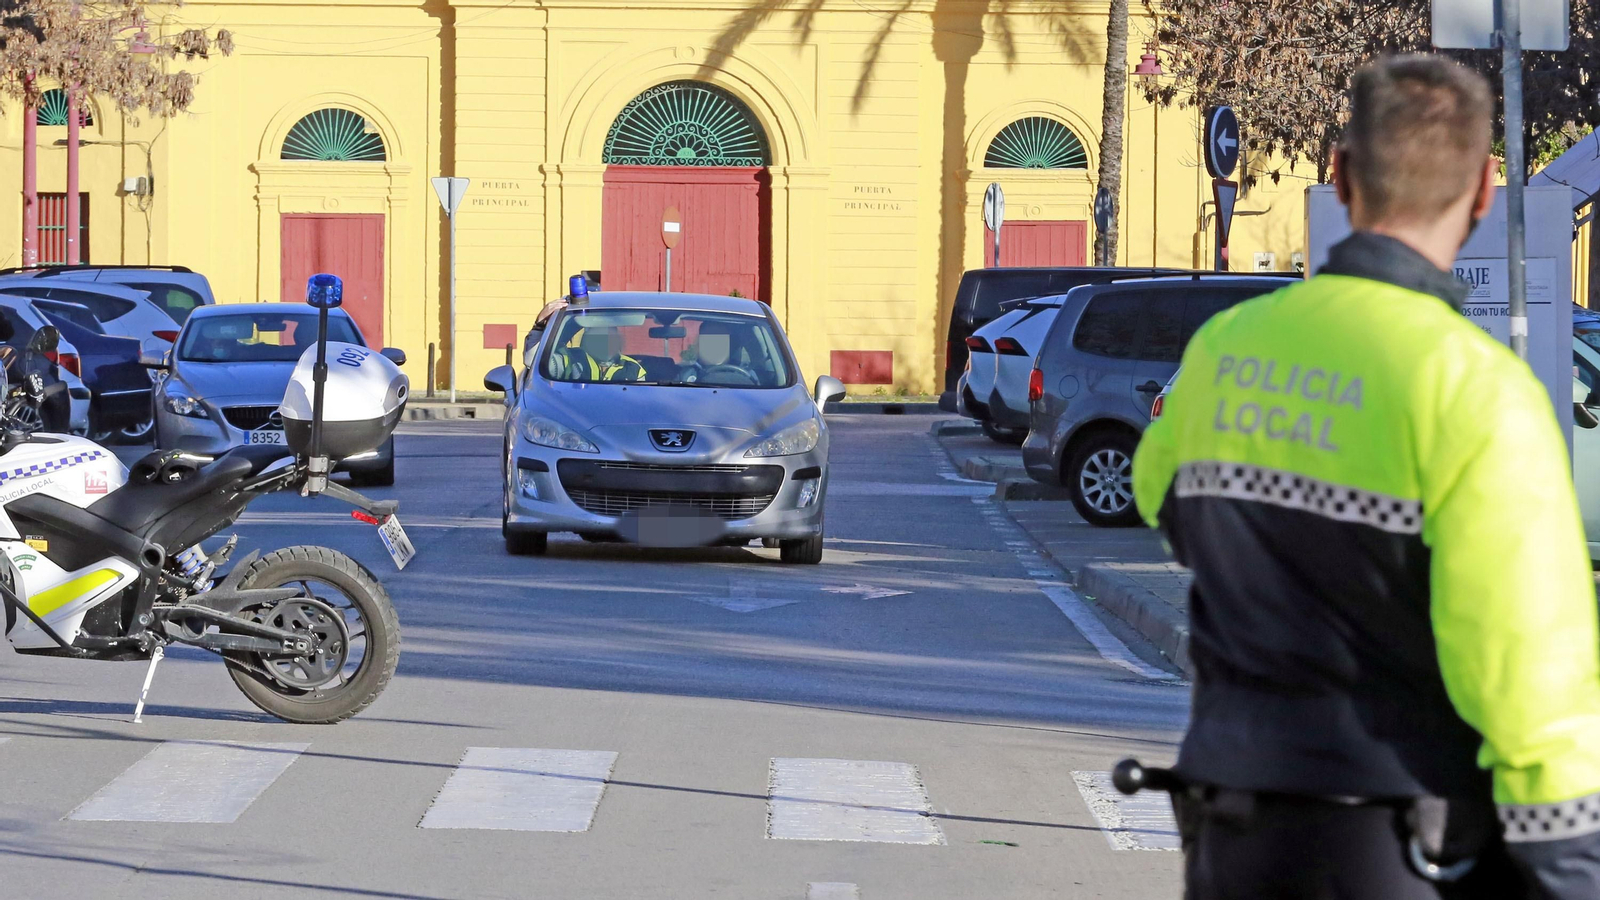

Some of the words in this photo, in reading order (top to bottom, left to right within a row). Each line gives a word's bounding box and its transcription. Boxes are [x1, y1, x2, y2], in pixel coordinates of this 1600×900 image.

[482, 181, 520, 189] PUERTA
[854, 185, 892, 194] PUERTA
[472, 198, 530, 207] PRINCIPAL
[844, 202, 902, 211] PRINCIPAL
[1453, 267, 1490, 290] RAJE
[1461, 307, 1471, 317] OS
[1472, 307, 1488, 317] CON
[1488, 307, 1499, 317] TU
[336, 347, 371, 368] 092
[1214, 354, 1364, 412] POLICIA
[1213, 398, 1340, 453] LOCAL
[252, 432, 281, 444] 8352
[85, 470, 107, 487] 112
[0, 488, 26, 502] OLICIA
[26, 477, 54, 493] LOCAL
